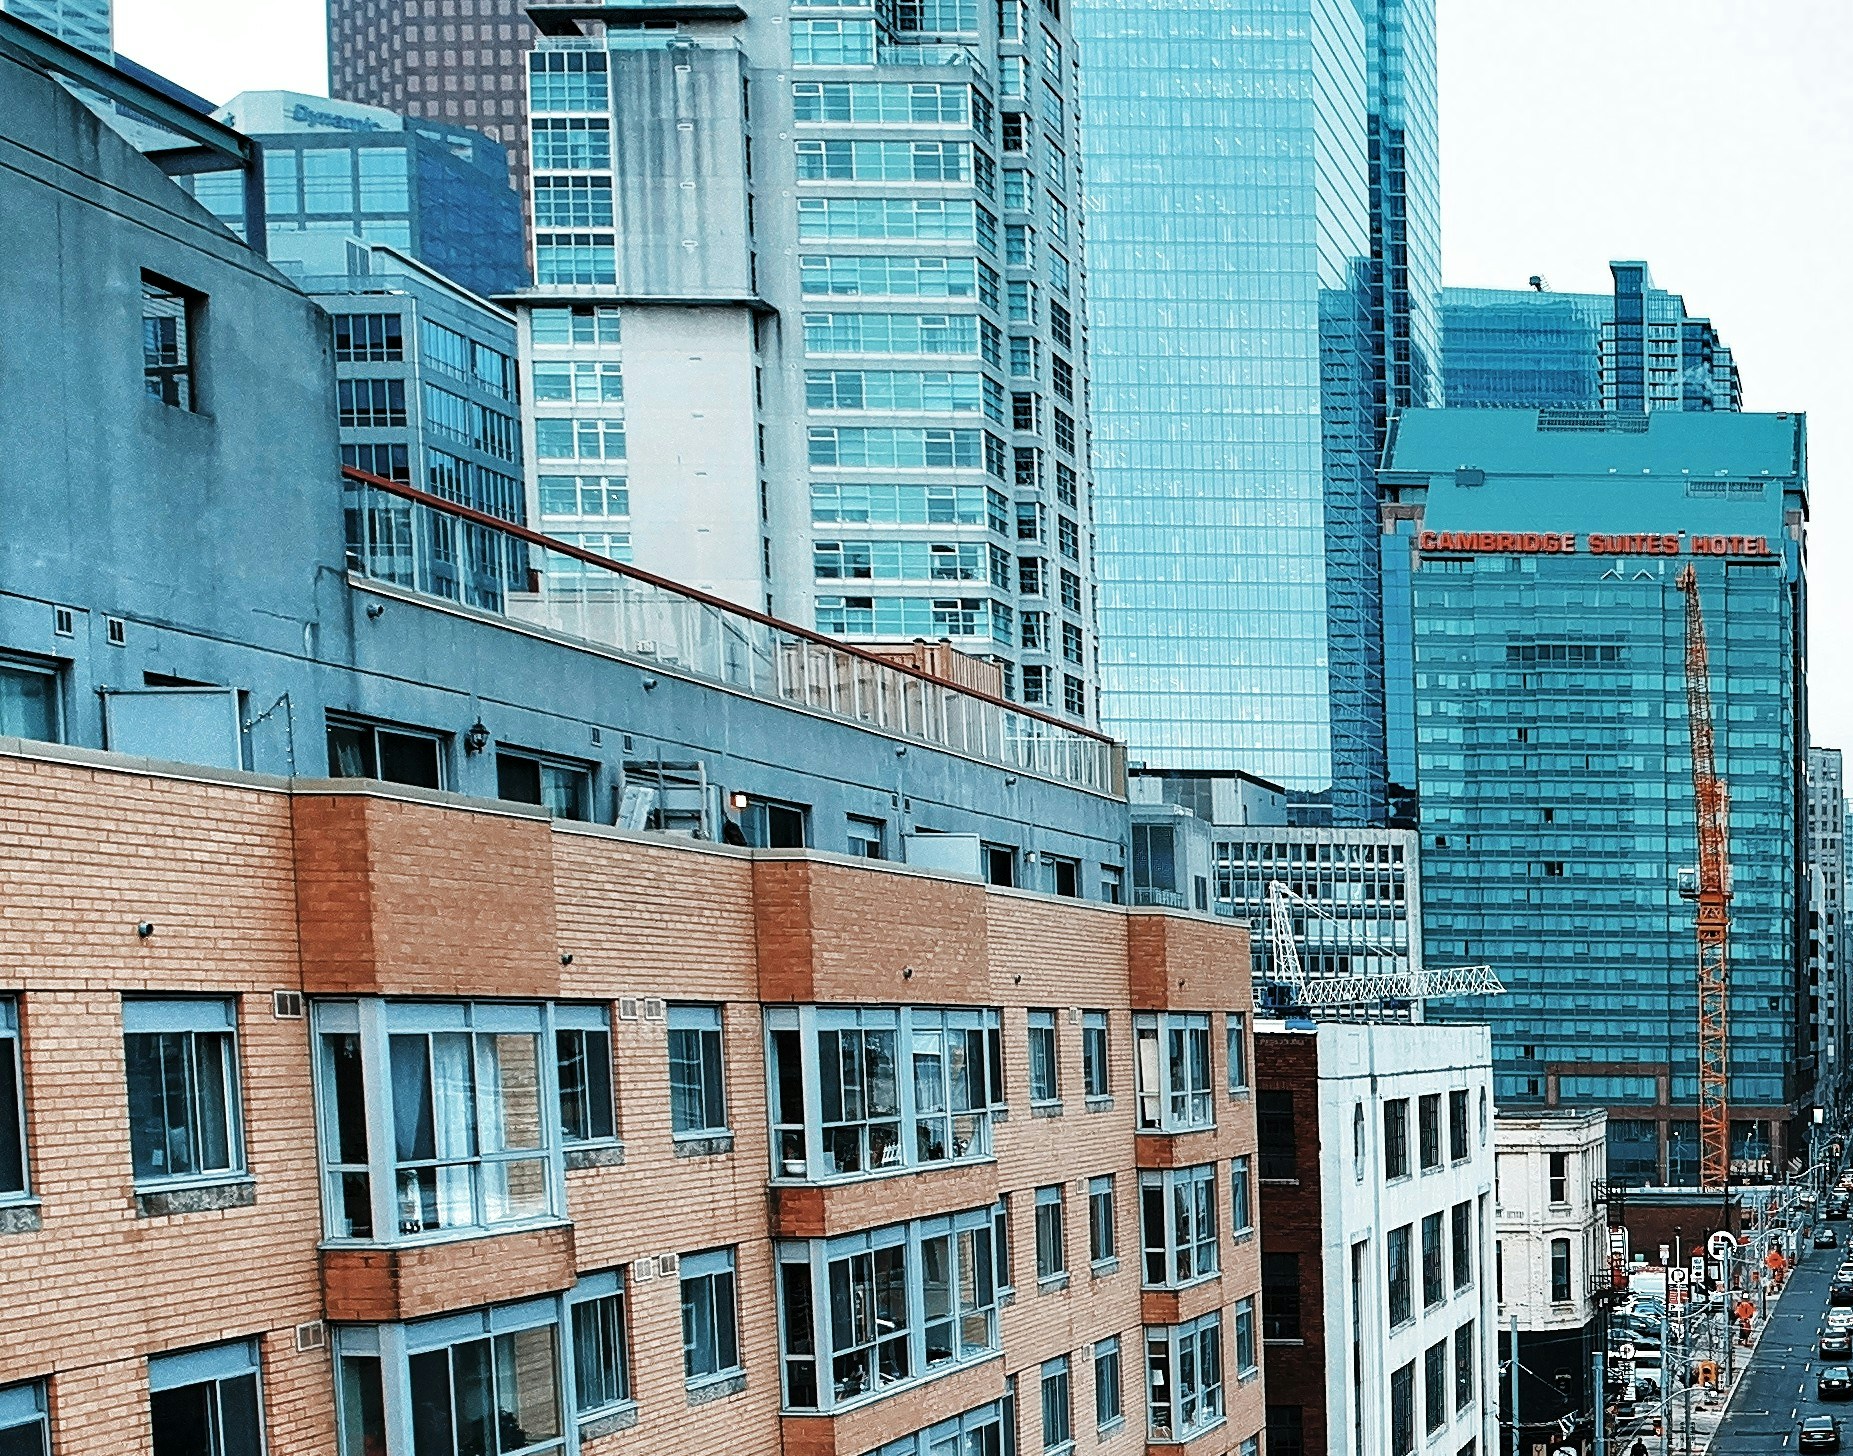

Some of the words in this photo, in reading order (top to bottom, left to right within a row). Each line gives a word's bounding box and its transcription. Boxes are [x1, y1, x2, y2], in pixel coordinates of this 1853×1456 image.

[1419, 531, 1576, 552] CAMBRIDGE
[1588, 534, 1679, 554] SUITES
[1691, 536, 1770, 555] HOTEL
